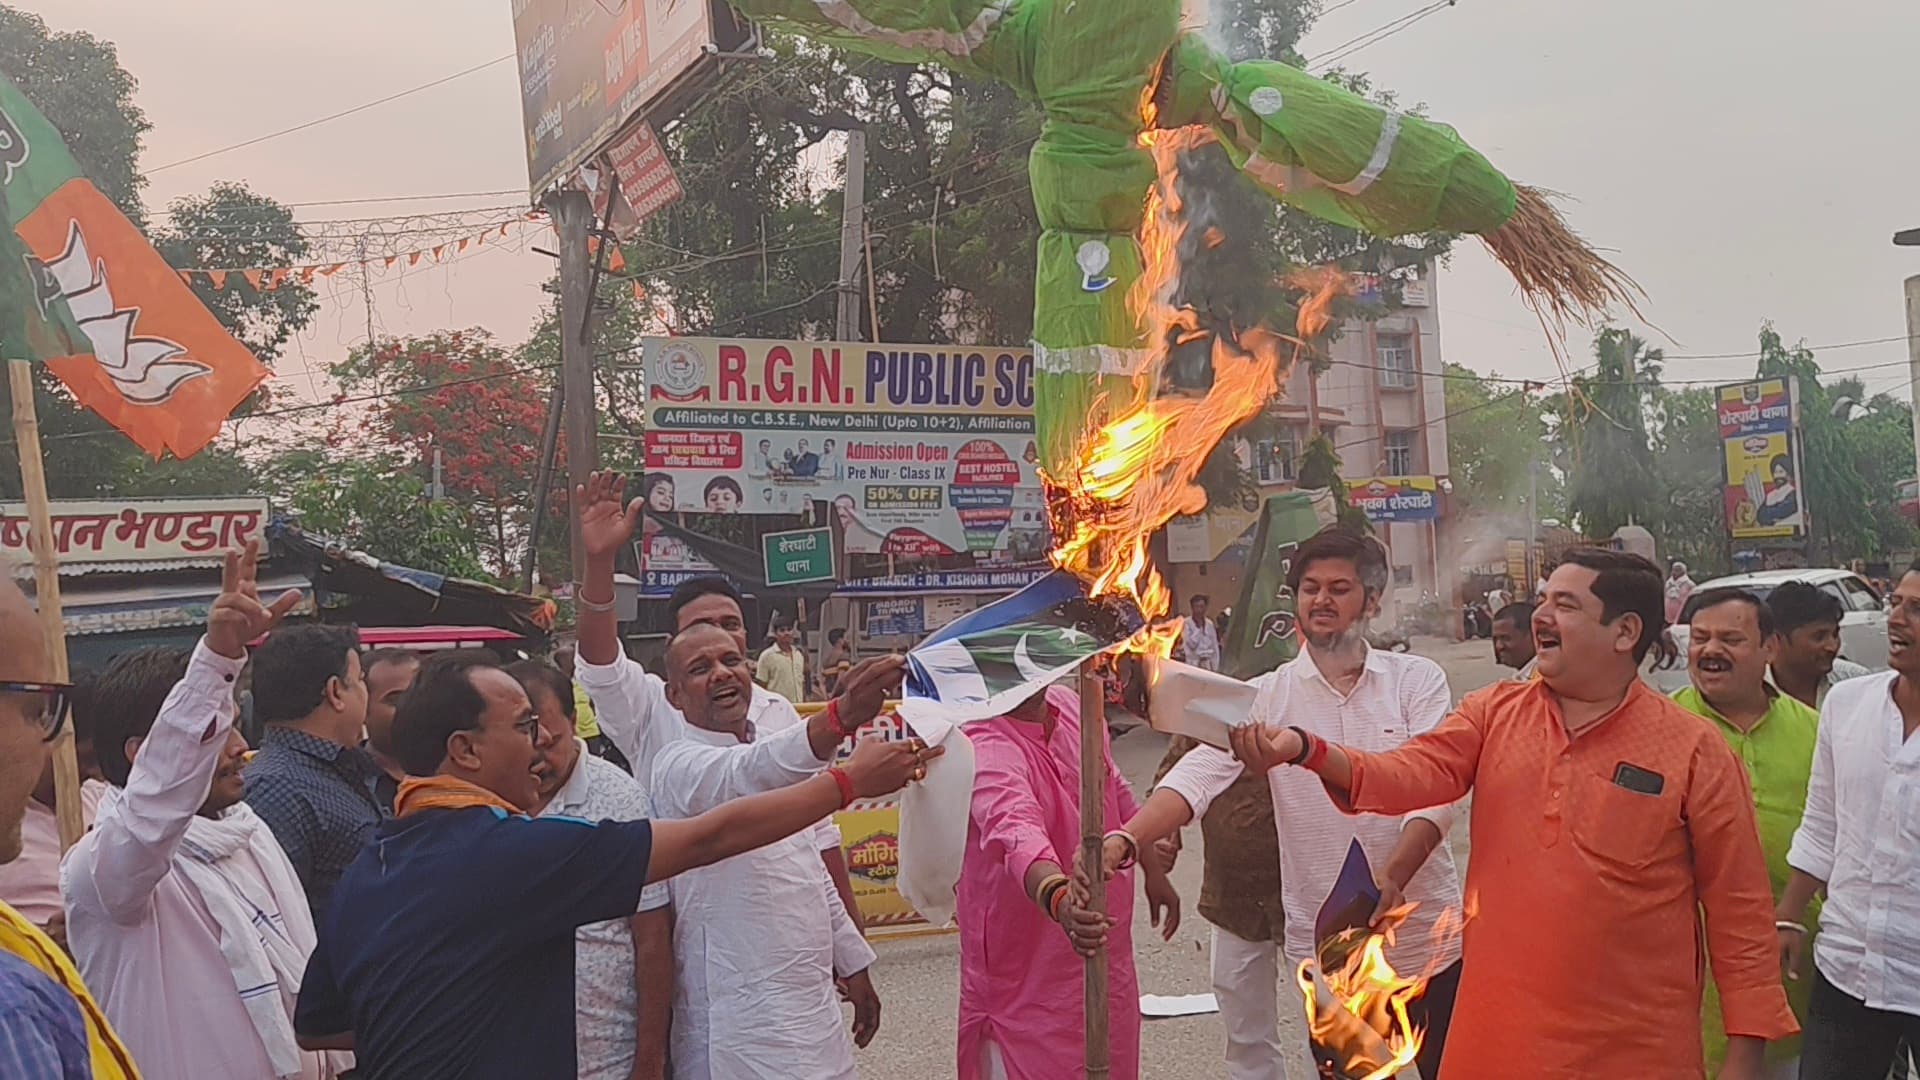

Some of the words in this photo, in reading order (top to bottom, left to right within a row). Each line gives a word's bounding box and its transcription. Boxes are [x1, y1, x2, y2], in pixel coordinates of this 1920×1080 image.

[719, 345, 853, 404] R.G.N.
[865, 351, 985, 406] PUBLIC
[994, 354, 1034, 407] SC
[665, 411, 728, 424] Affiliated
[733, 413, 746, 424] to
[751, 414, 804, 427] C.B.S.E.,
[809, 414, 840, 427] New
[845, 415, 878, 428] Delhi
[883, 416, 917, 430] (Upto
[924, 416, 963, 430] 10+2),
[968, 416, 1030, 430] Affiliation
[846, 441, 914, 461] Admission
[917, 442, 949, 462] Open
[970, 442, 994, 452] 100%
[848, 466, 866, 479] Pre
[870, 466, 889, 479] Nur
[900, 466, 930, 479] Class
[935, 467, 946, 479] IX
[959, 463, 982, 474] BEST
[983, 462, 1018, 473] HOSTEL
[867, 487, 903, 500] 50%
[908, 487, 939, 500] OFF
[1389, 492, 1432, 510] शेरघाटी
[115, 508, 262, 551] भण्डार
[779, 534, 817, 553] शेरघाटी
[786, 559, 810, 573] थाना
[925, 575, 944, 587] DR.
[946, 573, 988, 586] KISHORI
[991, 572, 1029, 585] MOHAN
